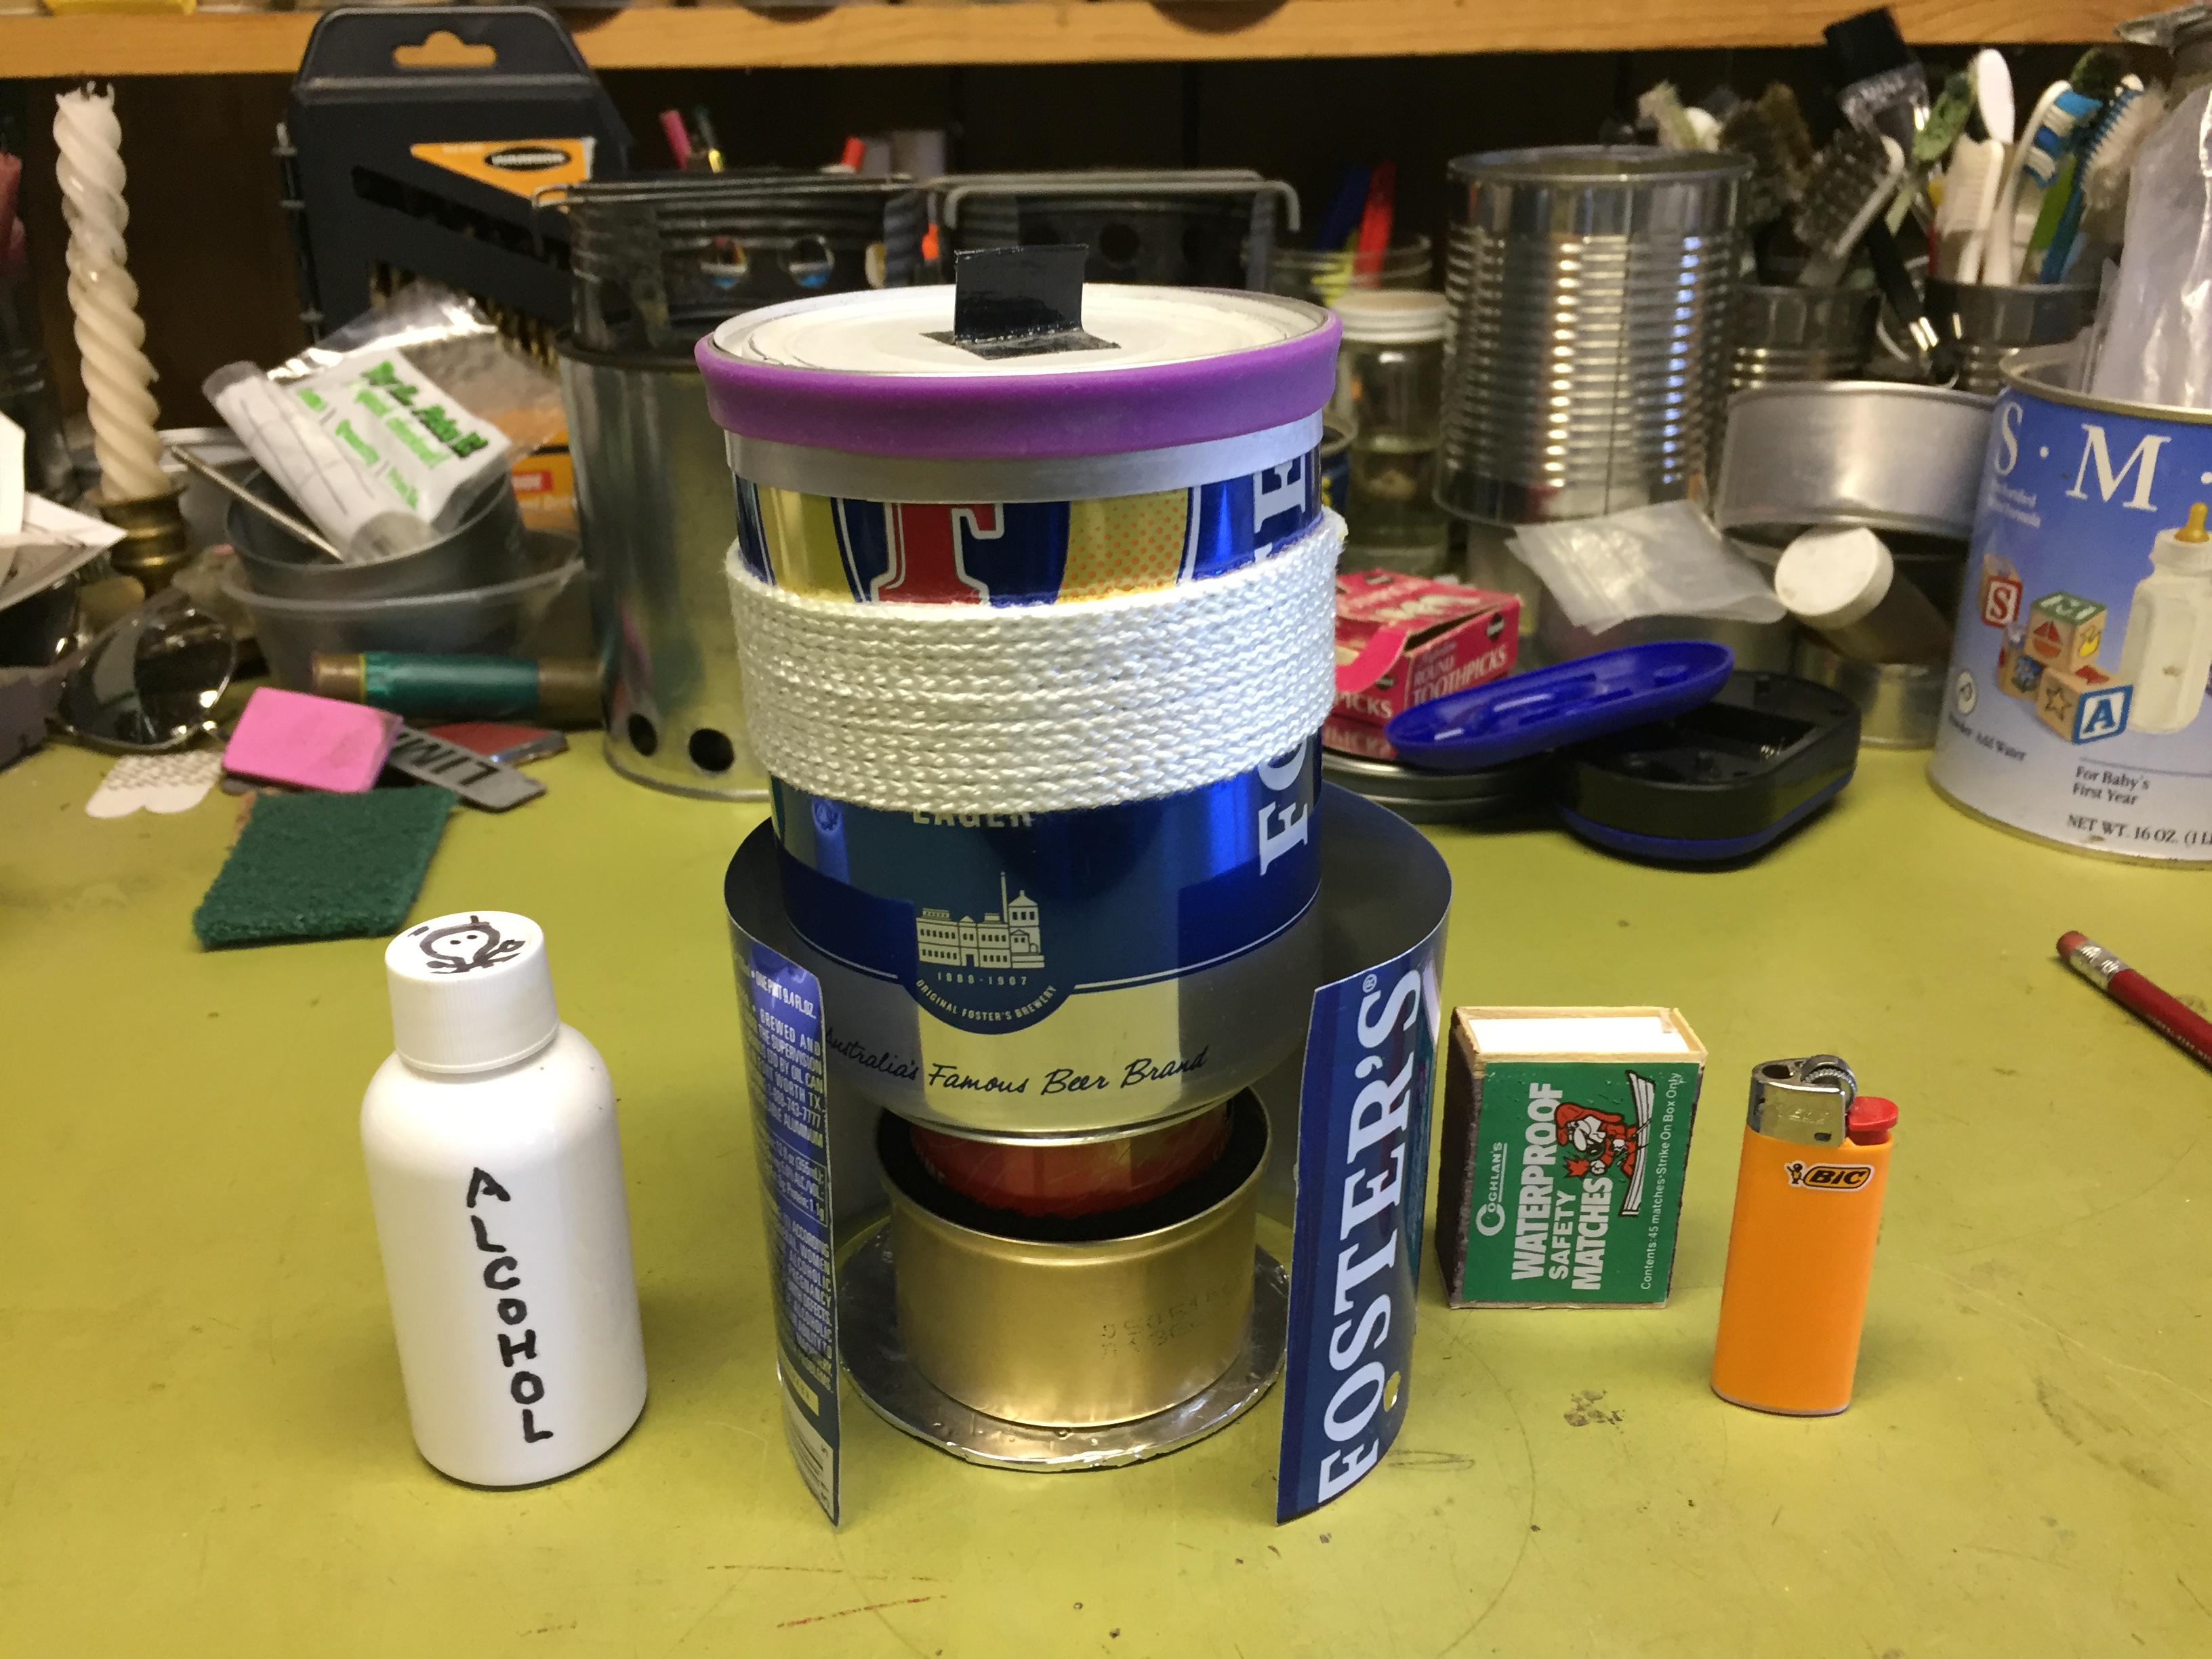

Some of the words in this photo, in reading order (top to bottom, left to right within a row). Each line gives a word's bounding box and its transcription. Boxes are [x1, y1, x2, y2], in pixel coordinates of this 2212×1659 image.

[1414, 643, 1508, 705] TOOTHPICKS
[2083, 697, 2118, 735] A
[2072, 782, 2103, 800] First
[2107, 788, 2139, 806] Year
[2075, 764, 2100, 781] For
[2102, 770, 2150, 792] Baby's
[2068, 813, 2099, 832] NET
[916, 978, 958, 1015] ORIGINAL
[961, 1008, 1012, 1022] FOSTER'S
[1014, 984, 1057, 1019] BREWERY
[760, 1008, 795, 1043] BREWED
[800, 1032, 820, 1057] AND
[928, 1062, 1029, 1095] Famous
[1040, 1068, 1110, 1097] Beer
[1119, 1044, 1210, 1090] Brand
[1665, 1071, 1681, 1097] Only
[1662, 1123, 1673, 1140] On
[1664, 1097, 1674, 1122] Box
[1475, 1141, 1506, 1237] COGHLAN'S
[1511, 1082, 1563, 1280] WATERPROOF
[1809, 1169, 1868, 1186] BIC
[1549, 1190, 1577, 1280] SAFETY
[1572, 1176, 1614, 1291] MATCHES
[464, 1165, 554, 1444] ALCOHOL
